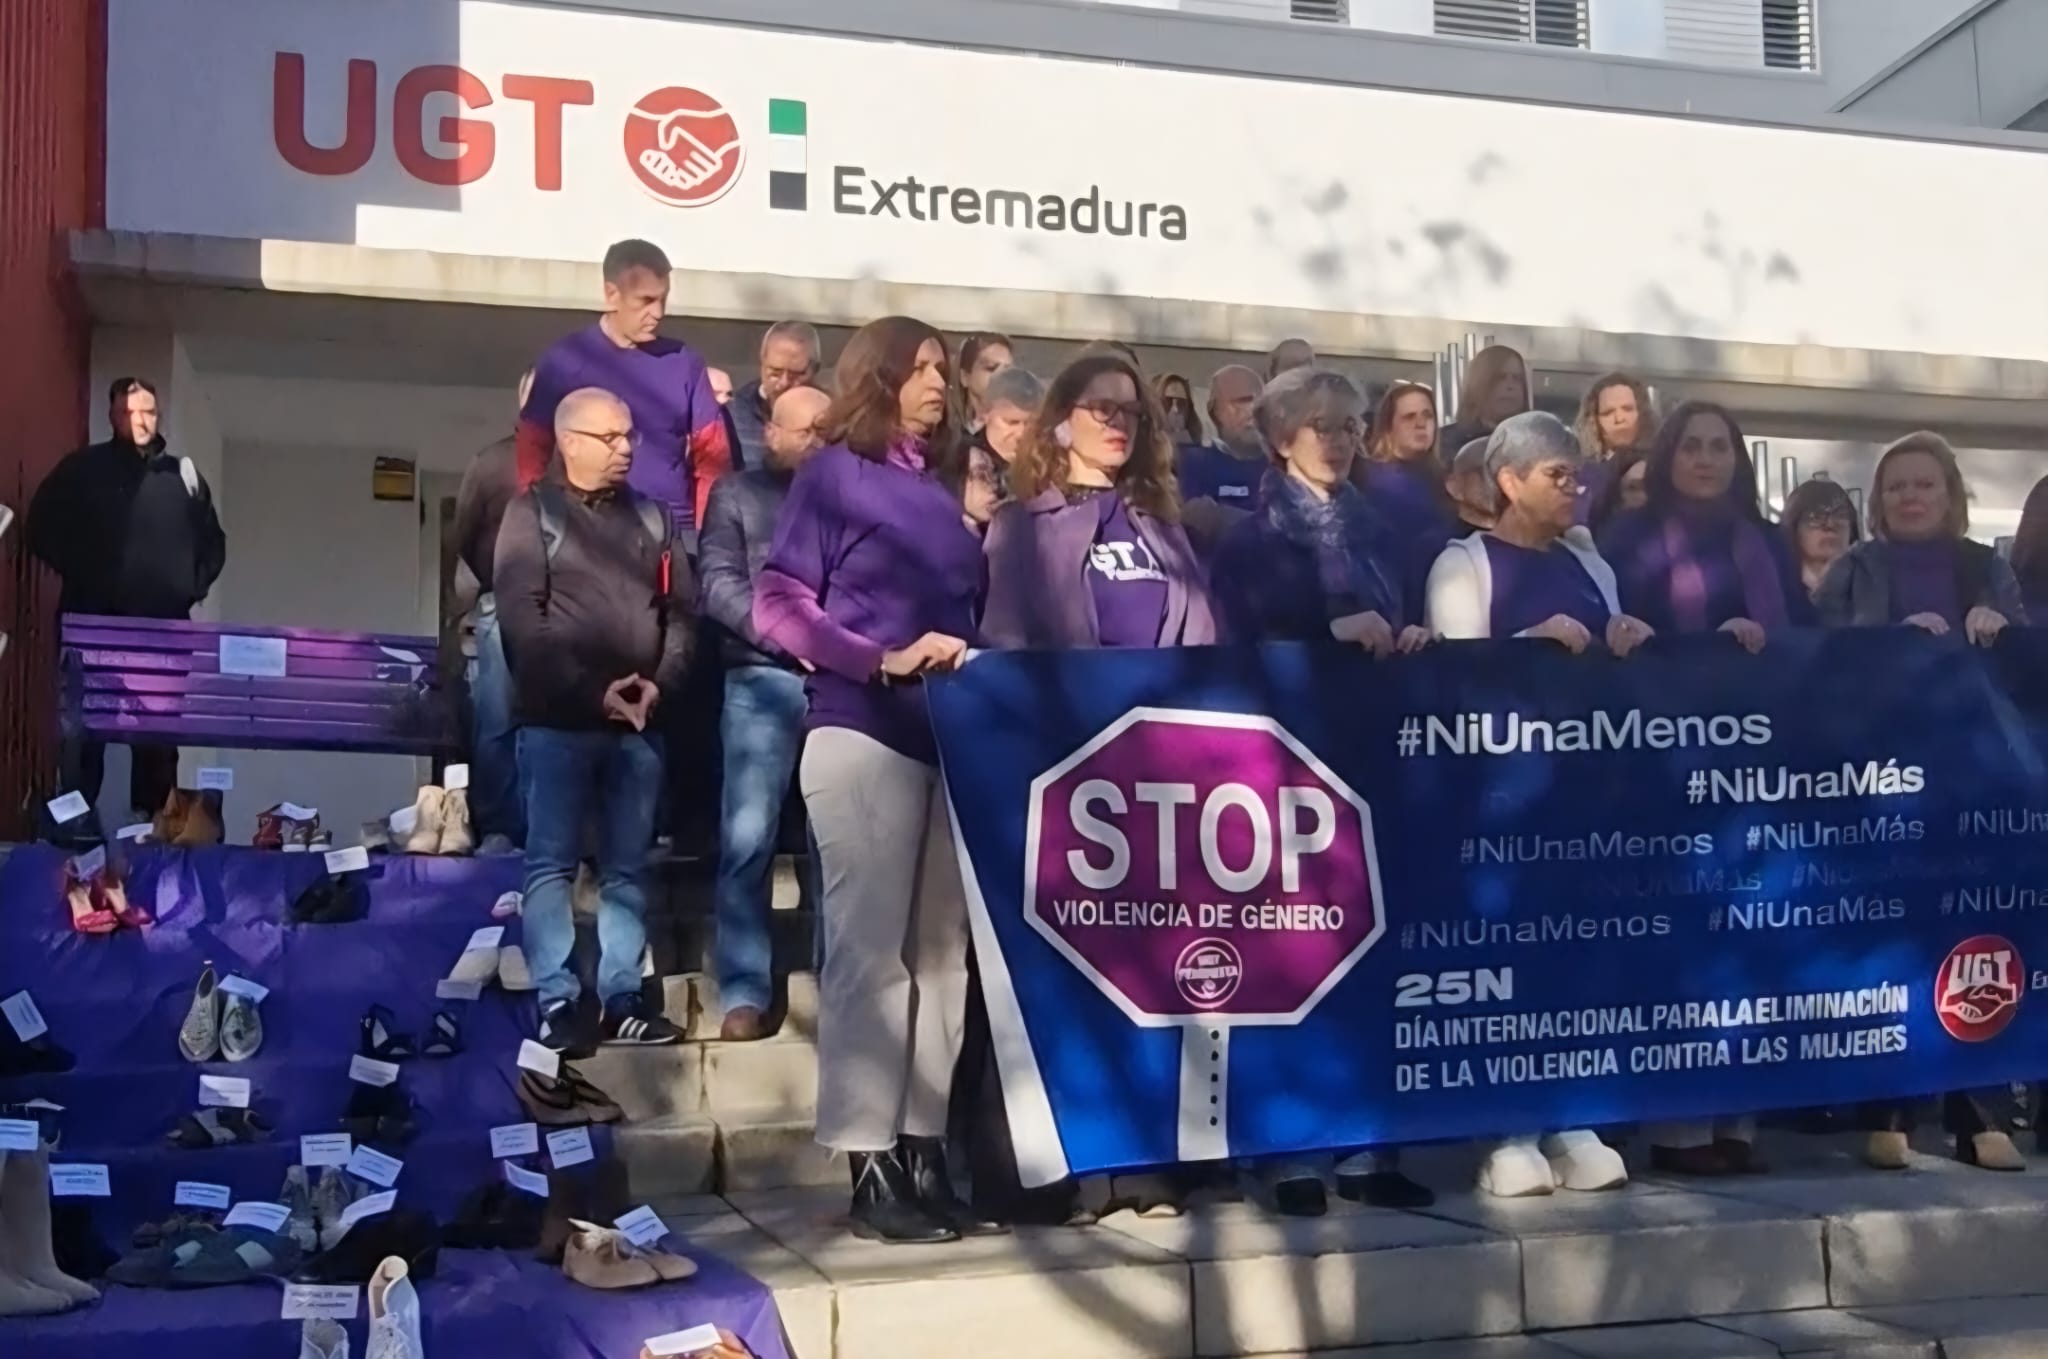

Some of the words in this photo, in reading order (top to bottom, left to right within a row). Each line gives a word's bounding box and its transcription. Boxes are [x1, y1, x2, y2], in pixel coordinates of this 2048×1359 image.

[273, 51, 594, 192] UGT
[834, 165, 1187, 241] Extremadura
[1397, 709, 1772, 756] #NiUnaMenos
[1686, 758, 1926, 804] #NiUnaMás
[1066, 778, 1336, 893] STOP
[1460, 830, 1714, 864] #NiUnaMenos
[1746, 813, 1925, 850] #NiUnaMás
[1053, 899, 1193, 927] VIOLENCIA
[1199, 903, 1234, 929] DE
[1240, 898, 1344, 931] GÉNERO
[1400, 914, 1672, 949] #NiUnaMenos
[1394, 966, 1513, 1008] 25N
[1948, 949, 2013, 990] UGT
[1395, 1015, 1441, 1049] DÍA
[1444, 1005, 1649, 1047] INTERNACIONAL
[1755, 980, 1908, 1025] ELIMINACIÓN
[1396, 1063, 1431, 1092] DE
[1441, 1059, 1475, 1088] LA
[1485, 1047, 1620, 1085] VIOLENCIA
[1630, 1039, 1731, 1075] CONTRA
[1742, 1036, 1788, 1064] LAS
[1800, 1024, 1908, 1060] MUJERES
